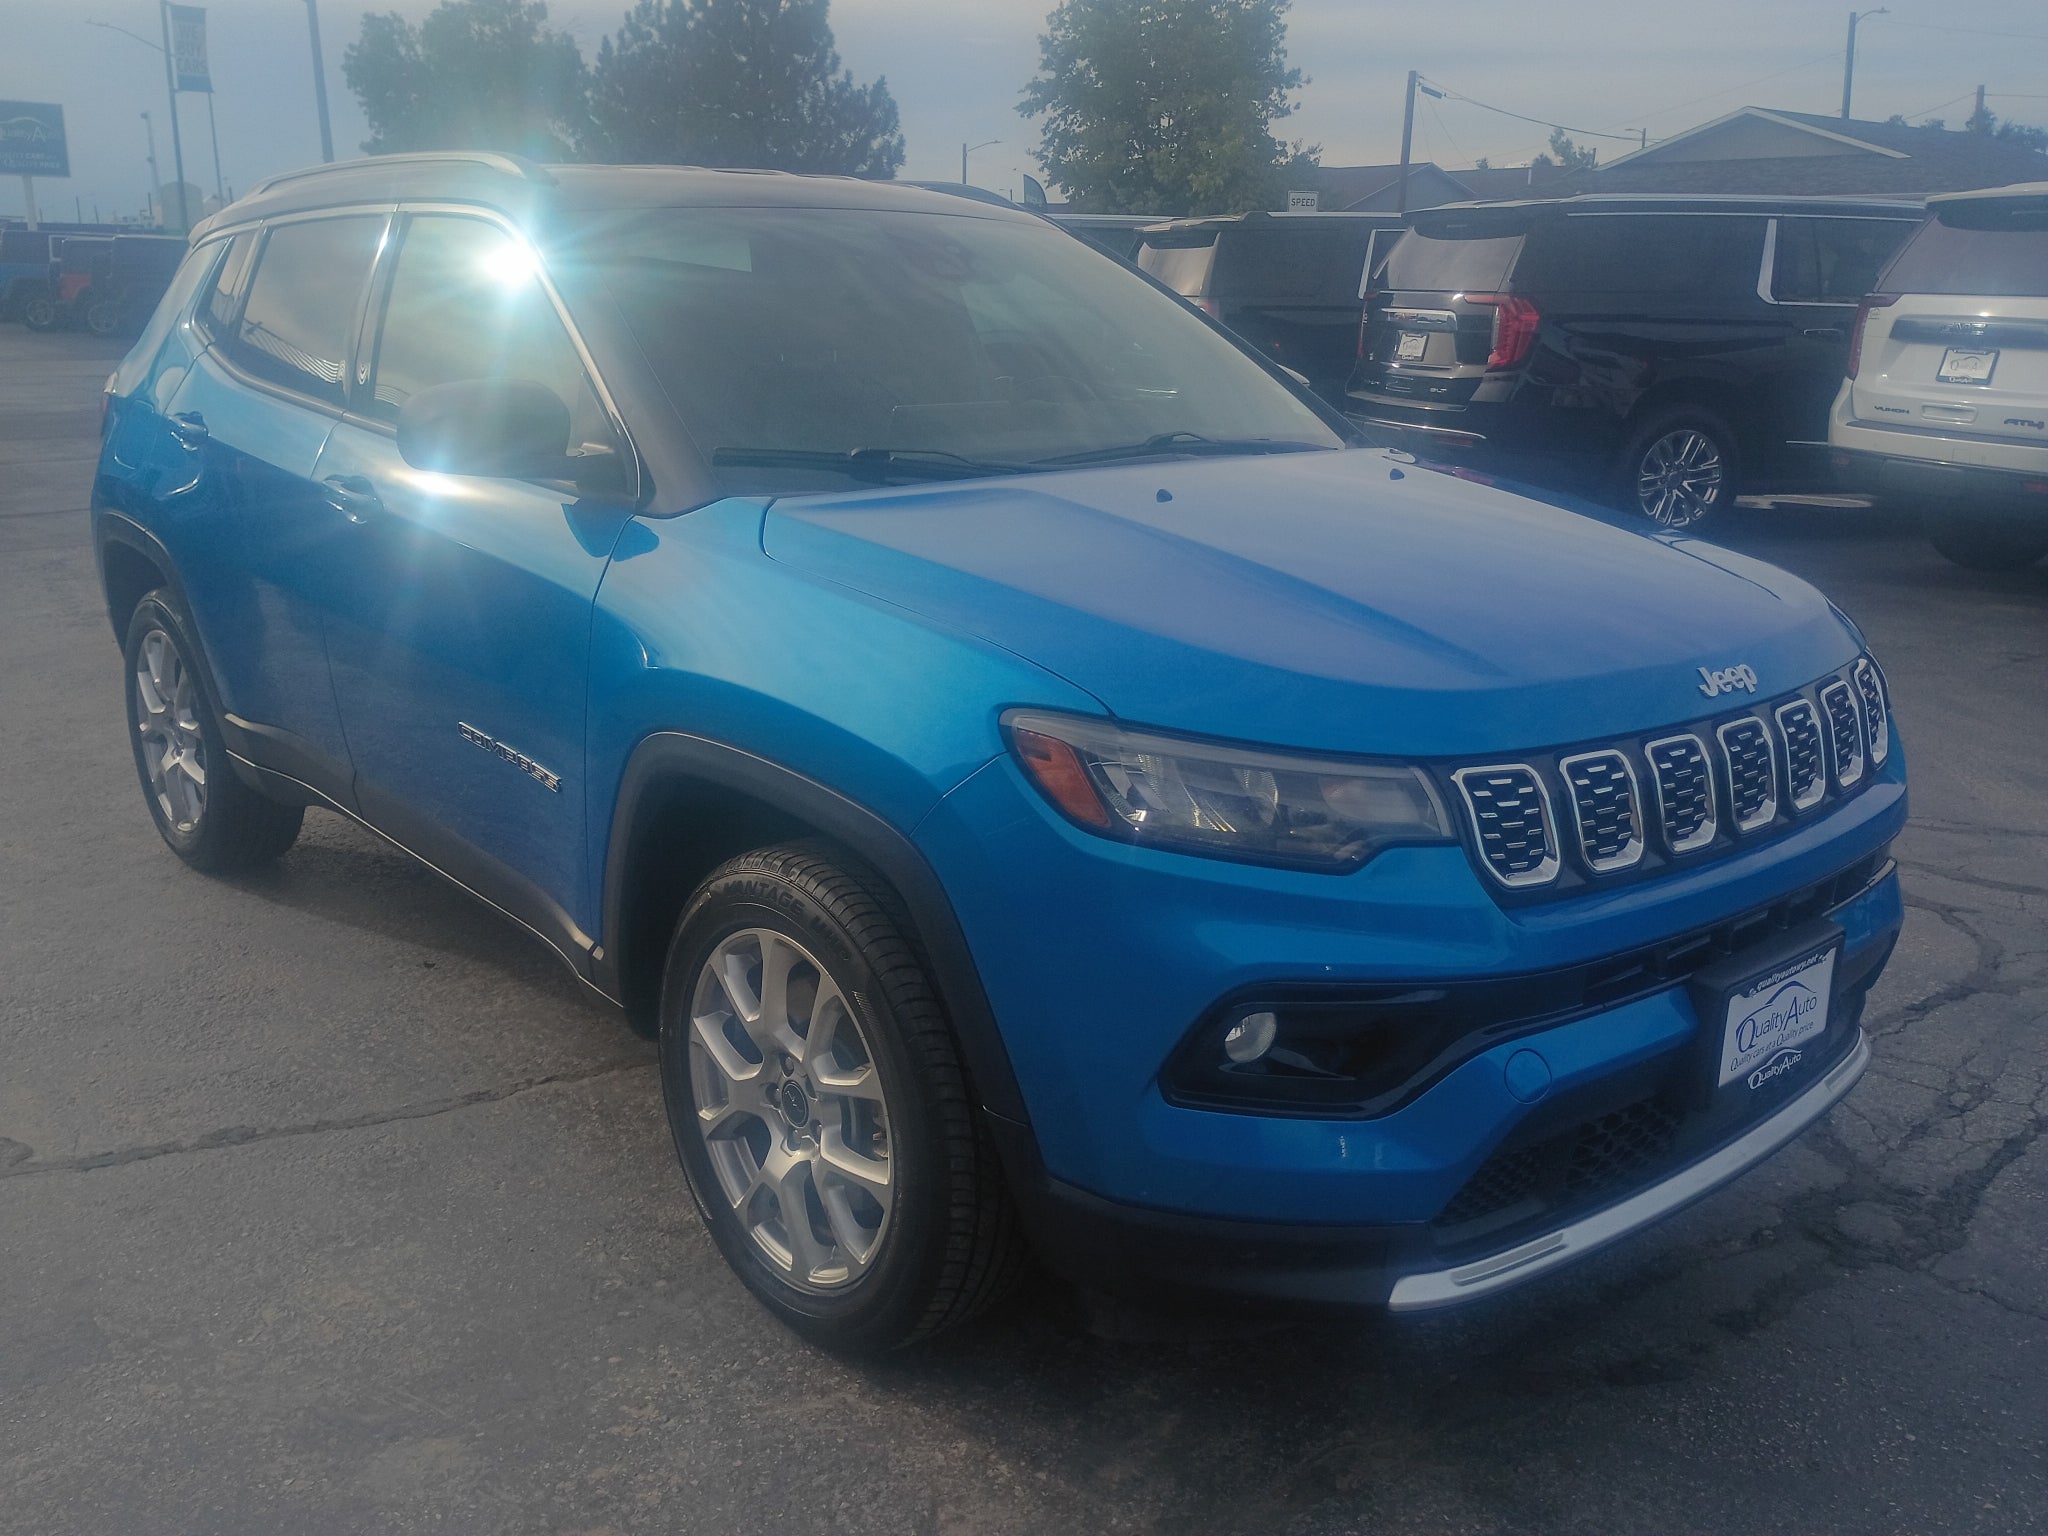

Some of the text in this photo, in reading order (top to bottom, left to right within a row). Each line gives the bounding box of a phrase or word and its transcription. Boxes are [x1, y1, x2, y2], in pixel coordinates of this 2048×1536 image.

[176, 58, 208, 73] CARS
[1291, 198, 1316, 207] SPEED
[1874, 405, 1910, 415] YUKON
[1697, 664, 1758, 697] Jeep
[457, 720, 562, 793] COMPASS
